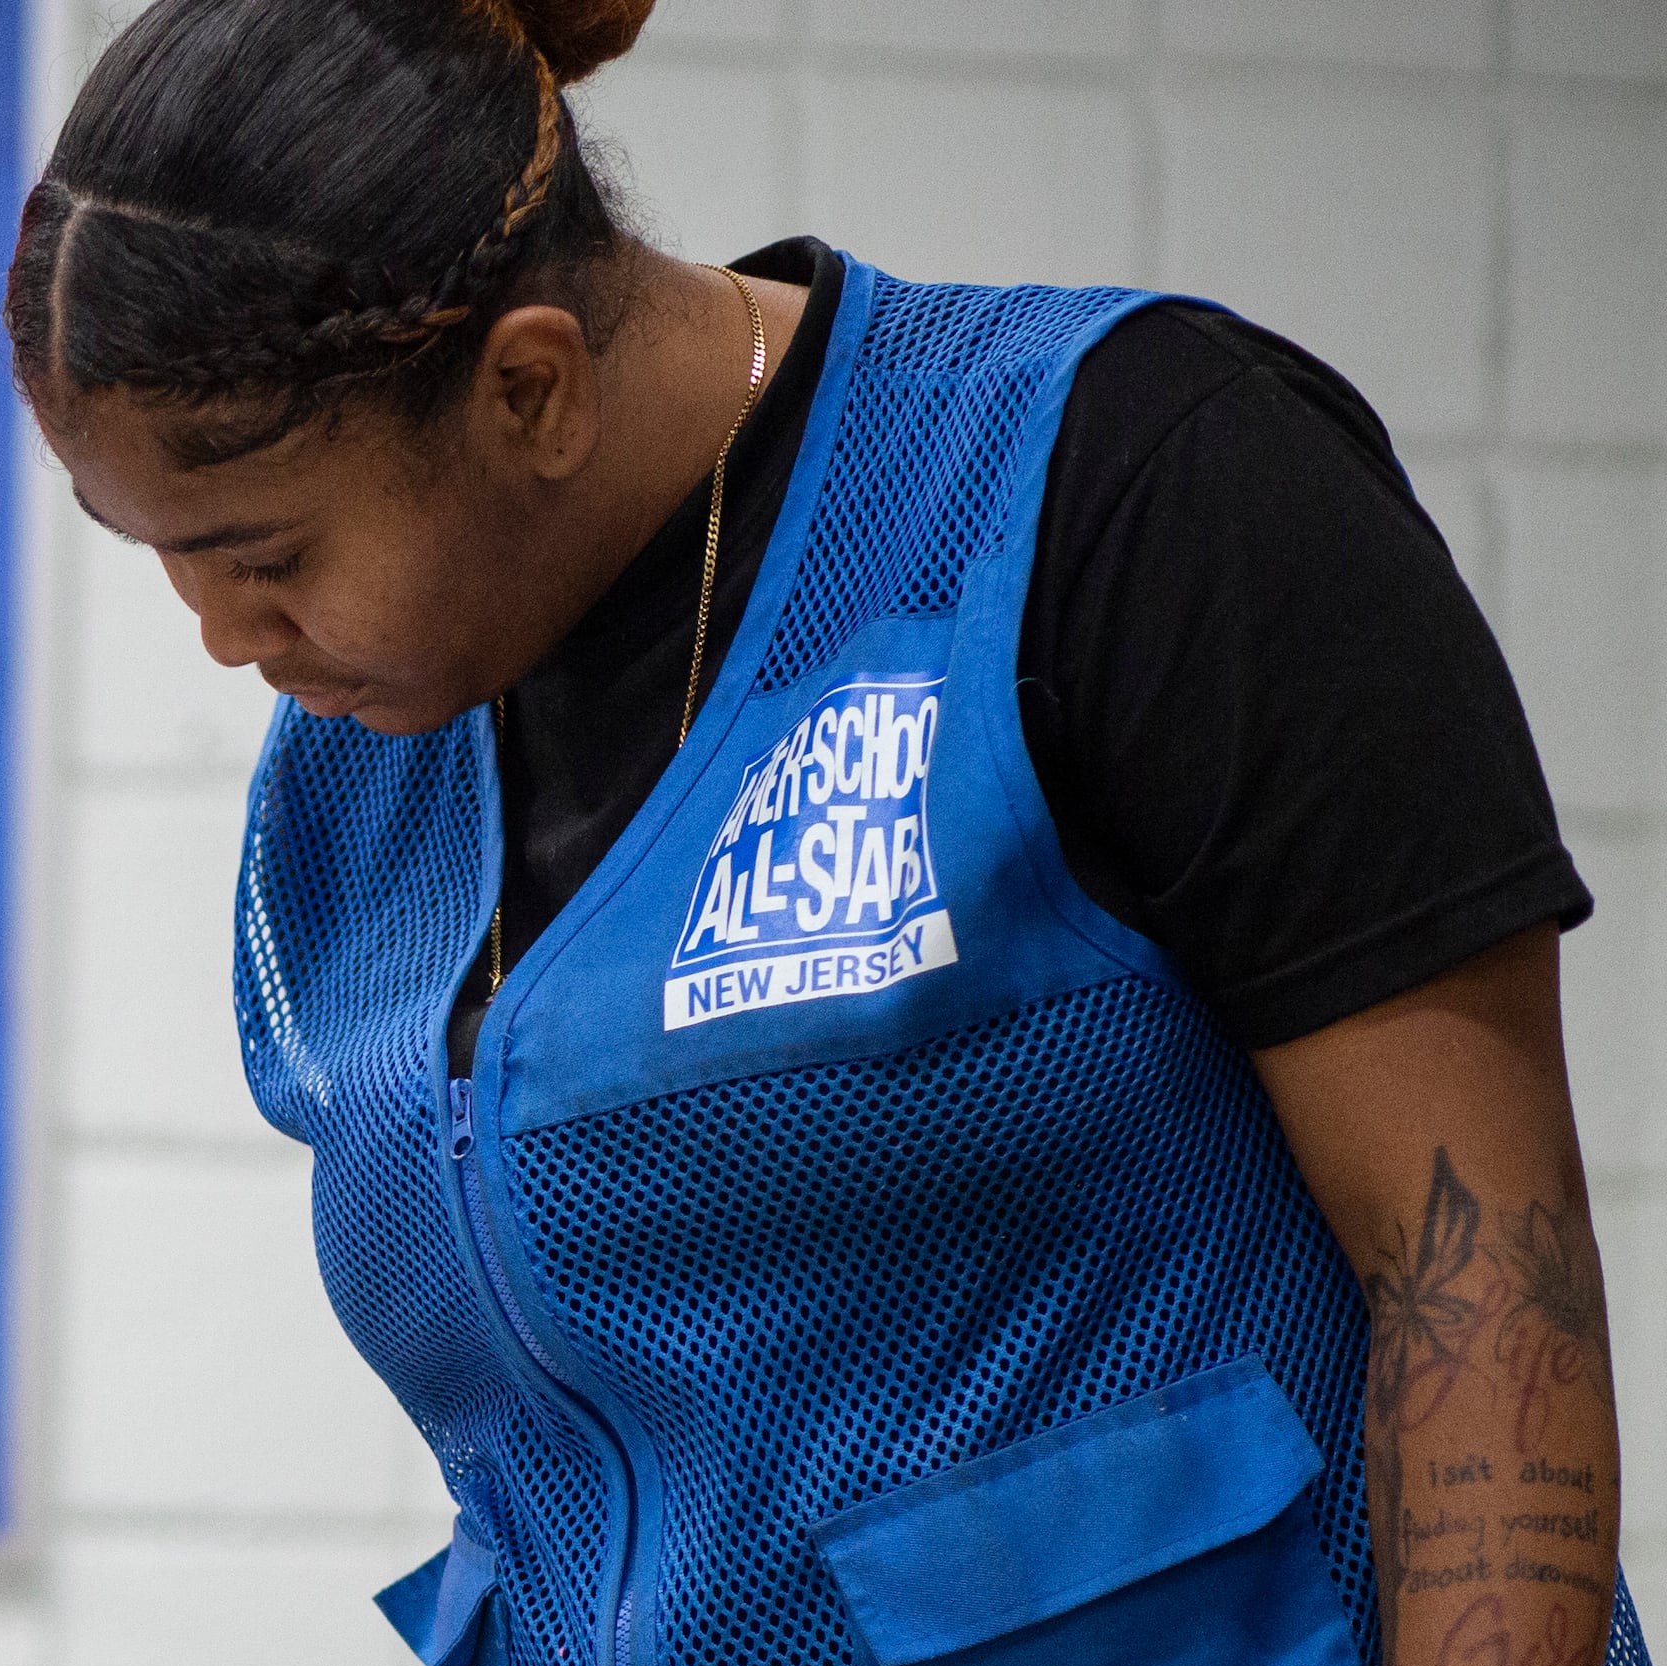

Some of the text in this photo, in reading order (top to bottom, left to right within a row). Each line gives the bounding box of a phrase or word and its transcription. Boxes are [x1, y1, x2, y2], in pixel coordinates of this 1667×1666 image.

[688, 925, 925, 1018] NEW JERSEY
[1519, 1457, 1595, 1494] about
[1500, 1508, 1599, 1548] yourself
